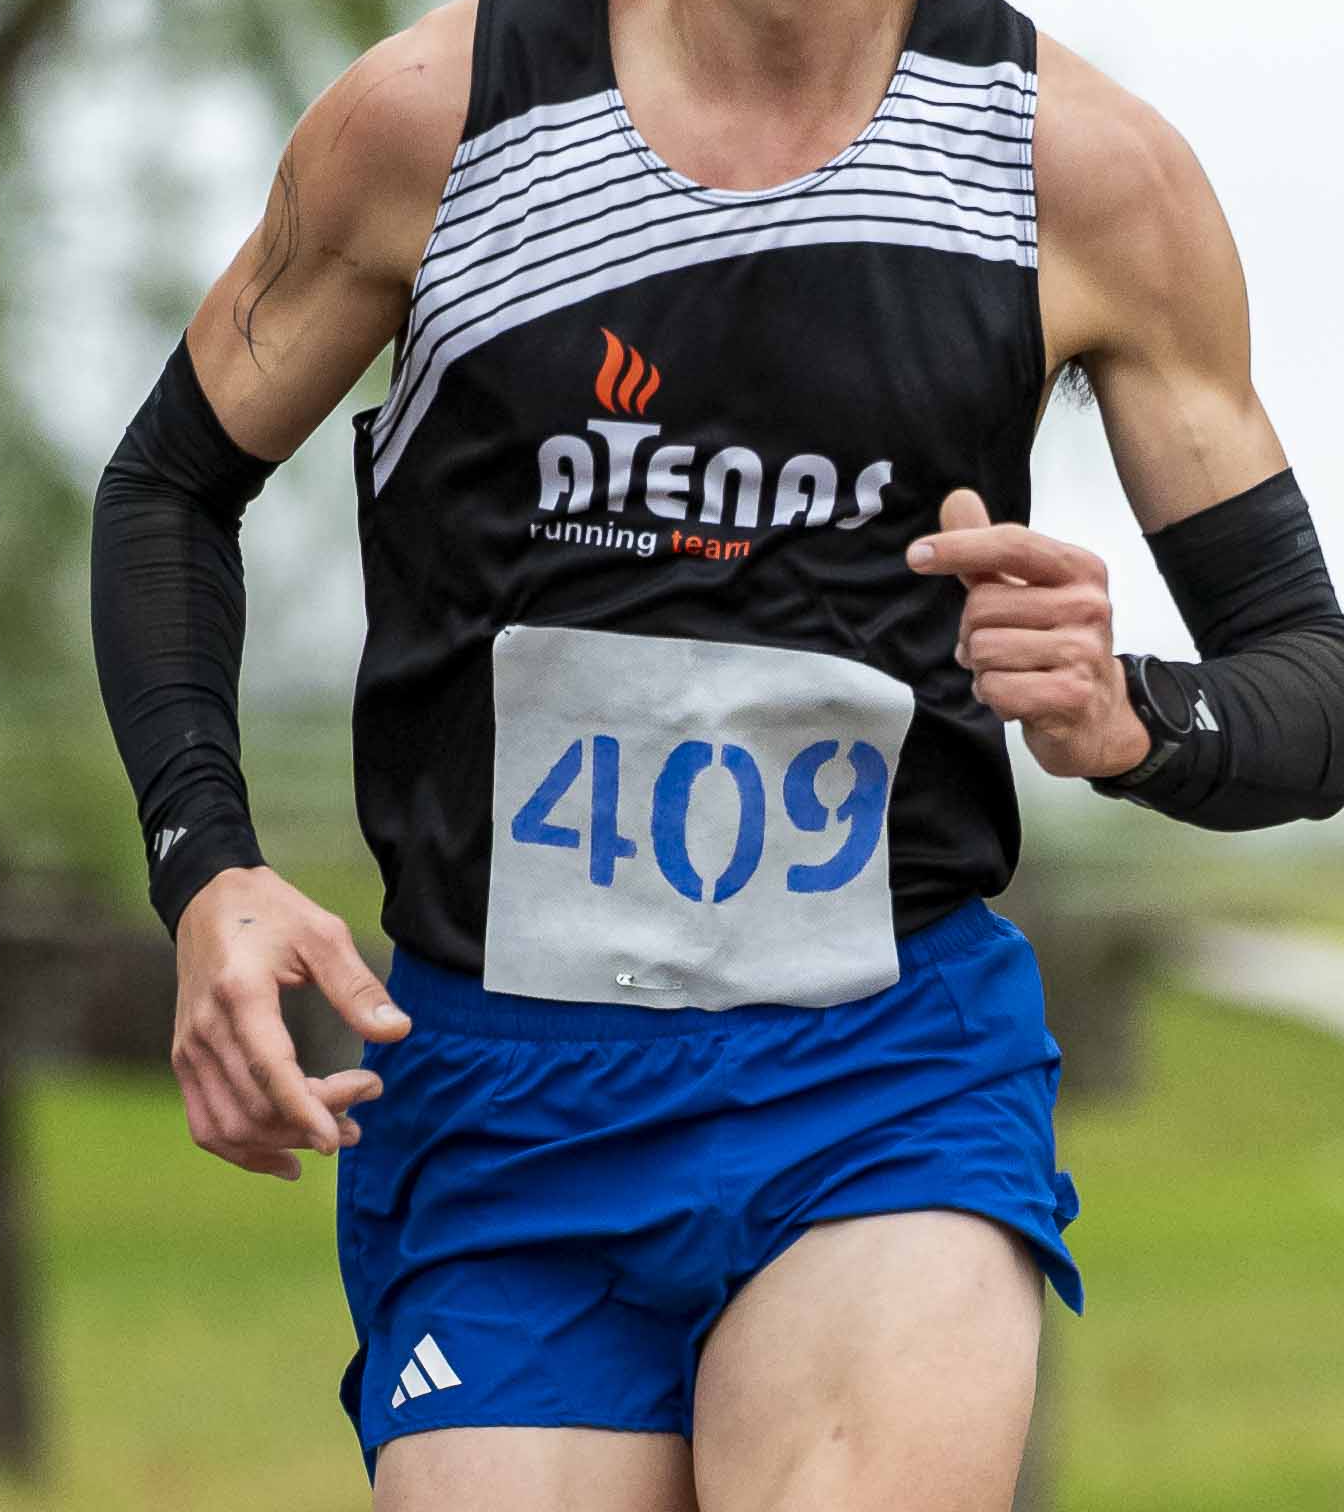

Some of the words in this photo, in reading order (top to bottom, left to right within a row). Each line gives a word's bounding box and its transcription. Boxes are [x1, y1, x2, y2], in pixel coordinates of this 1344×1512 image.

[537, 418, 895, 530] ATENAS
[529, 518, 657, 558] running
[671, 528, 752, 561] team
[511, 734, 891, 903] 409
